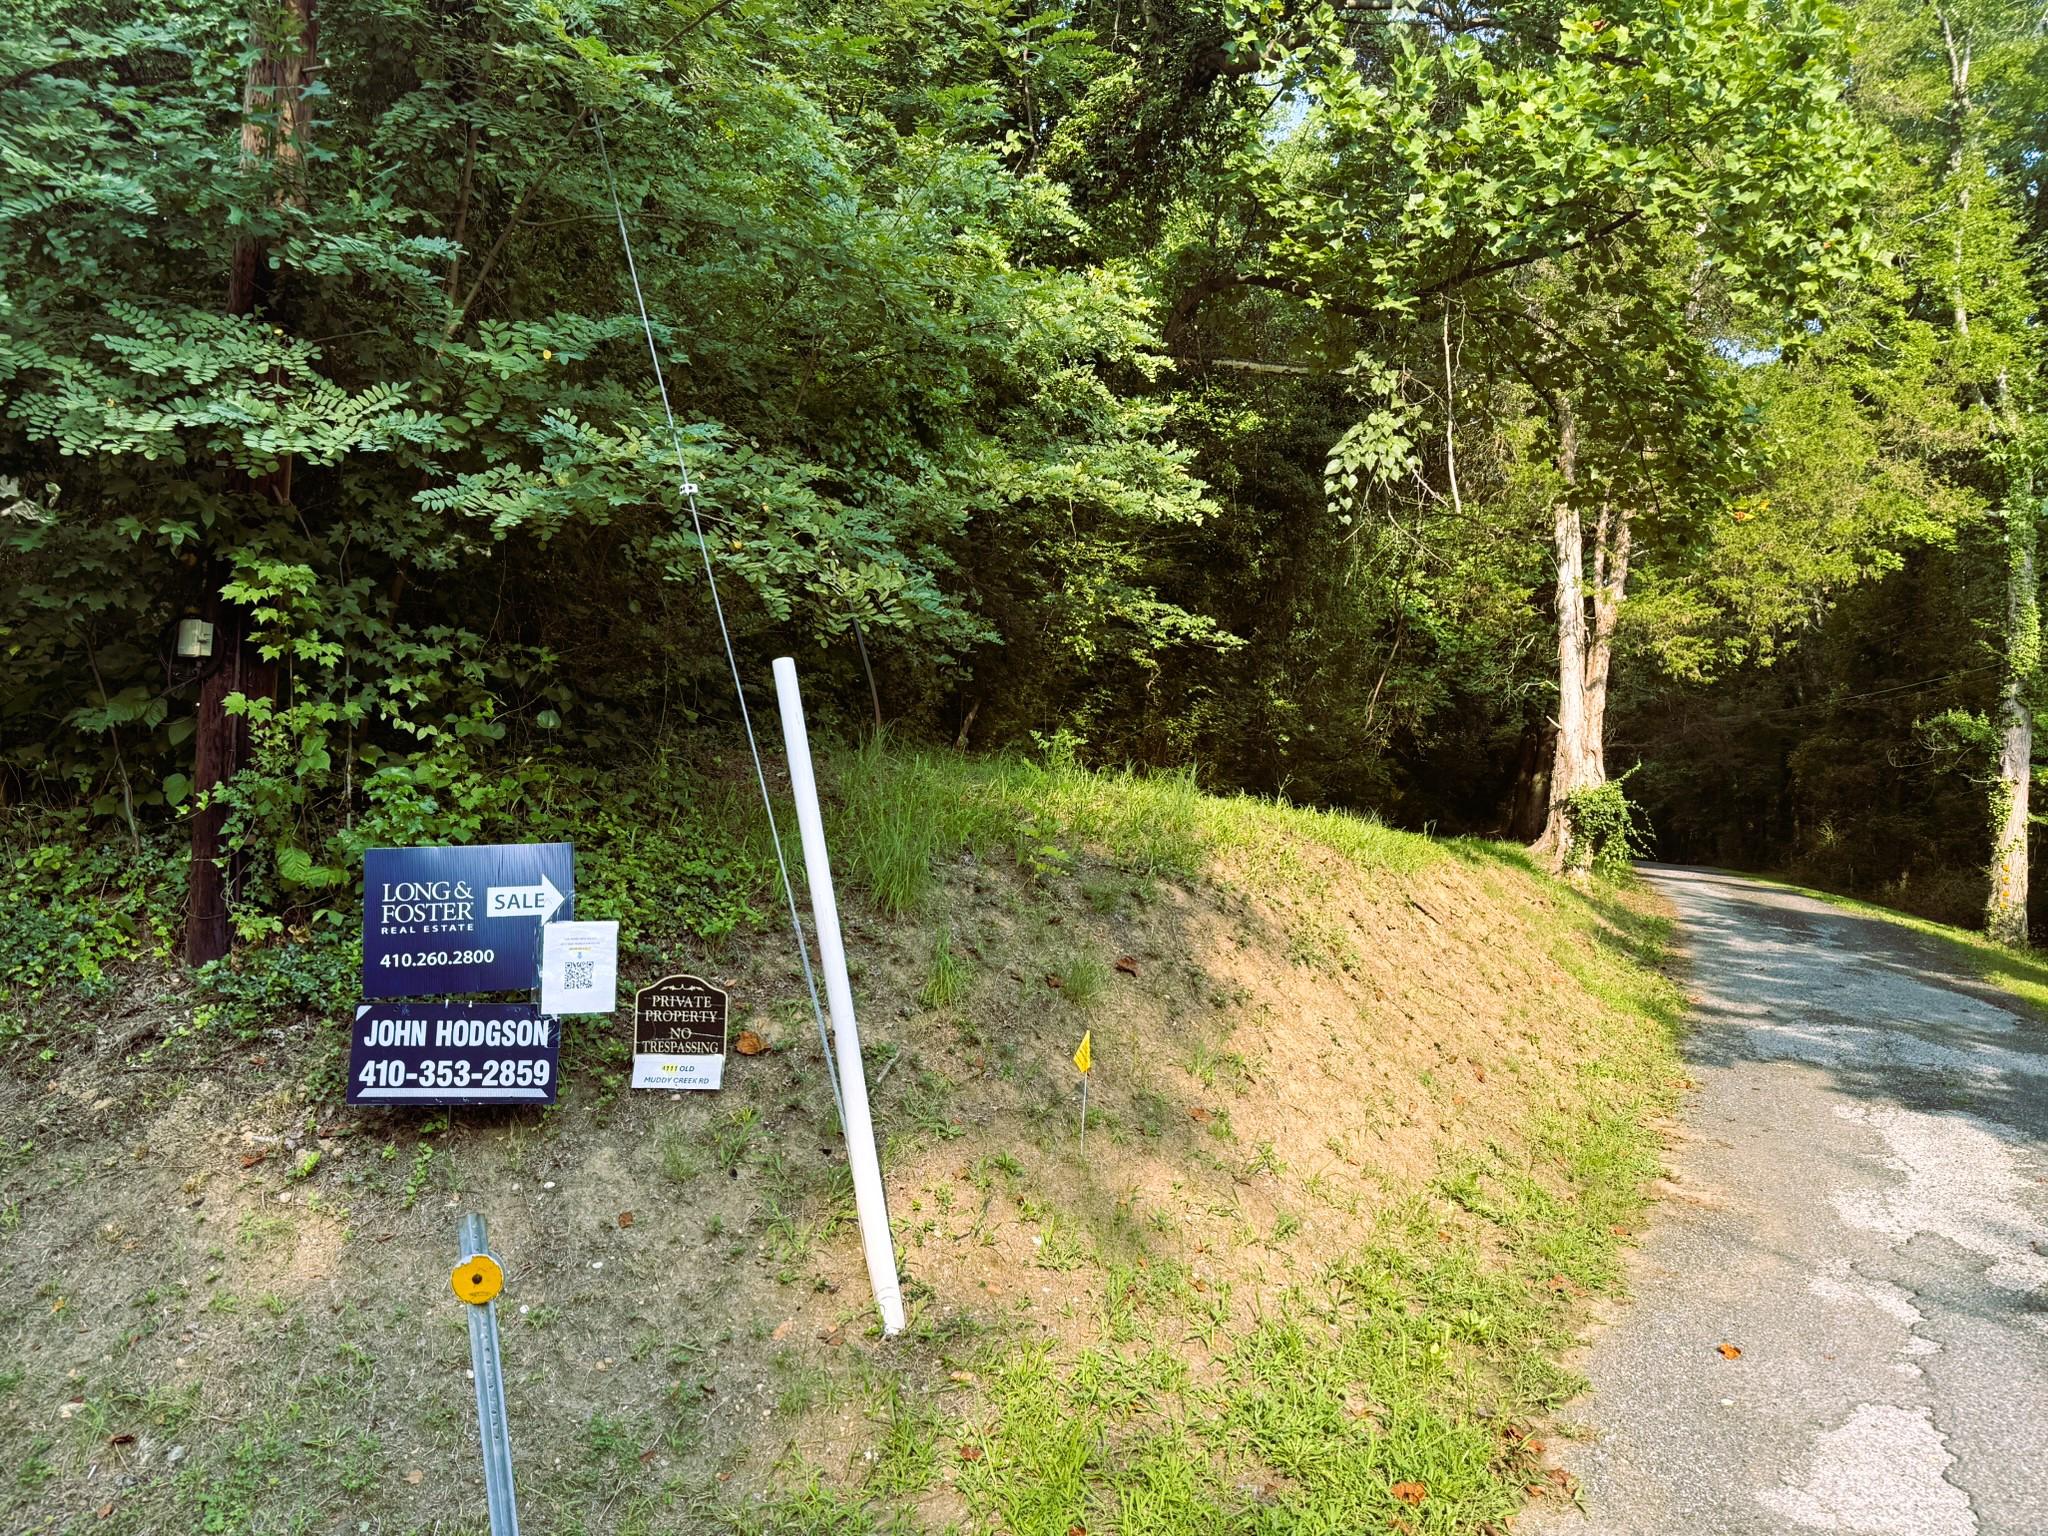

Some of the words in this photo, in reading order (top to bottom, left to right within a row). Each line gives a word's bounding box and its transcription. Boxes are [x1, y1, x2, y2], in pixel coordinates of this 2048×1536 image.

[382, 881, 450, 902] LONG
[494, 892, 545, 910] SALE
[381, 902, 474, 924] FOSTER
[381, 925, 416, 935] REAL
[423, 923, 474, 934] ESTATE
[379, 949, 495, 968] 410.260.2800
[652, 995, 712, 1008] PRIVATE
[645, 1010, 718, 1023] PROPERTY
[363, 1020, 427, 1047] JOHN
[435, 1020, 549, 1048] HODGSON
[670, 1027, 692, 1040] NO
[642, 1041, 719, 1054] TRESPASSING
[358, 1059, 550, 1087] 410-353-2859
